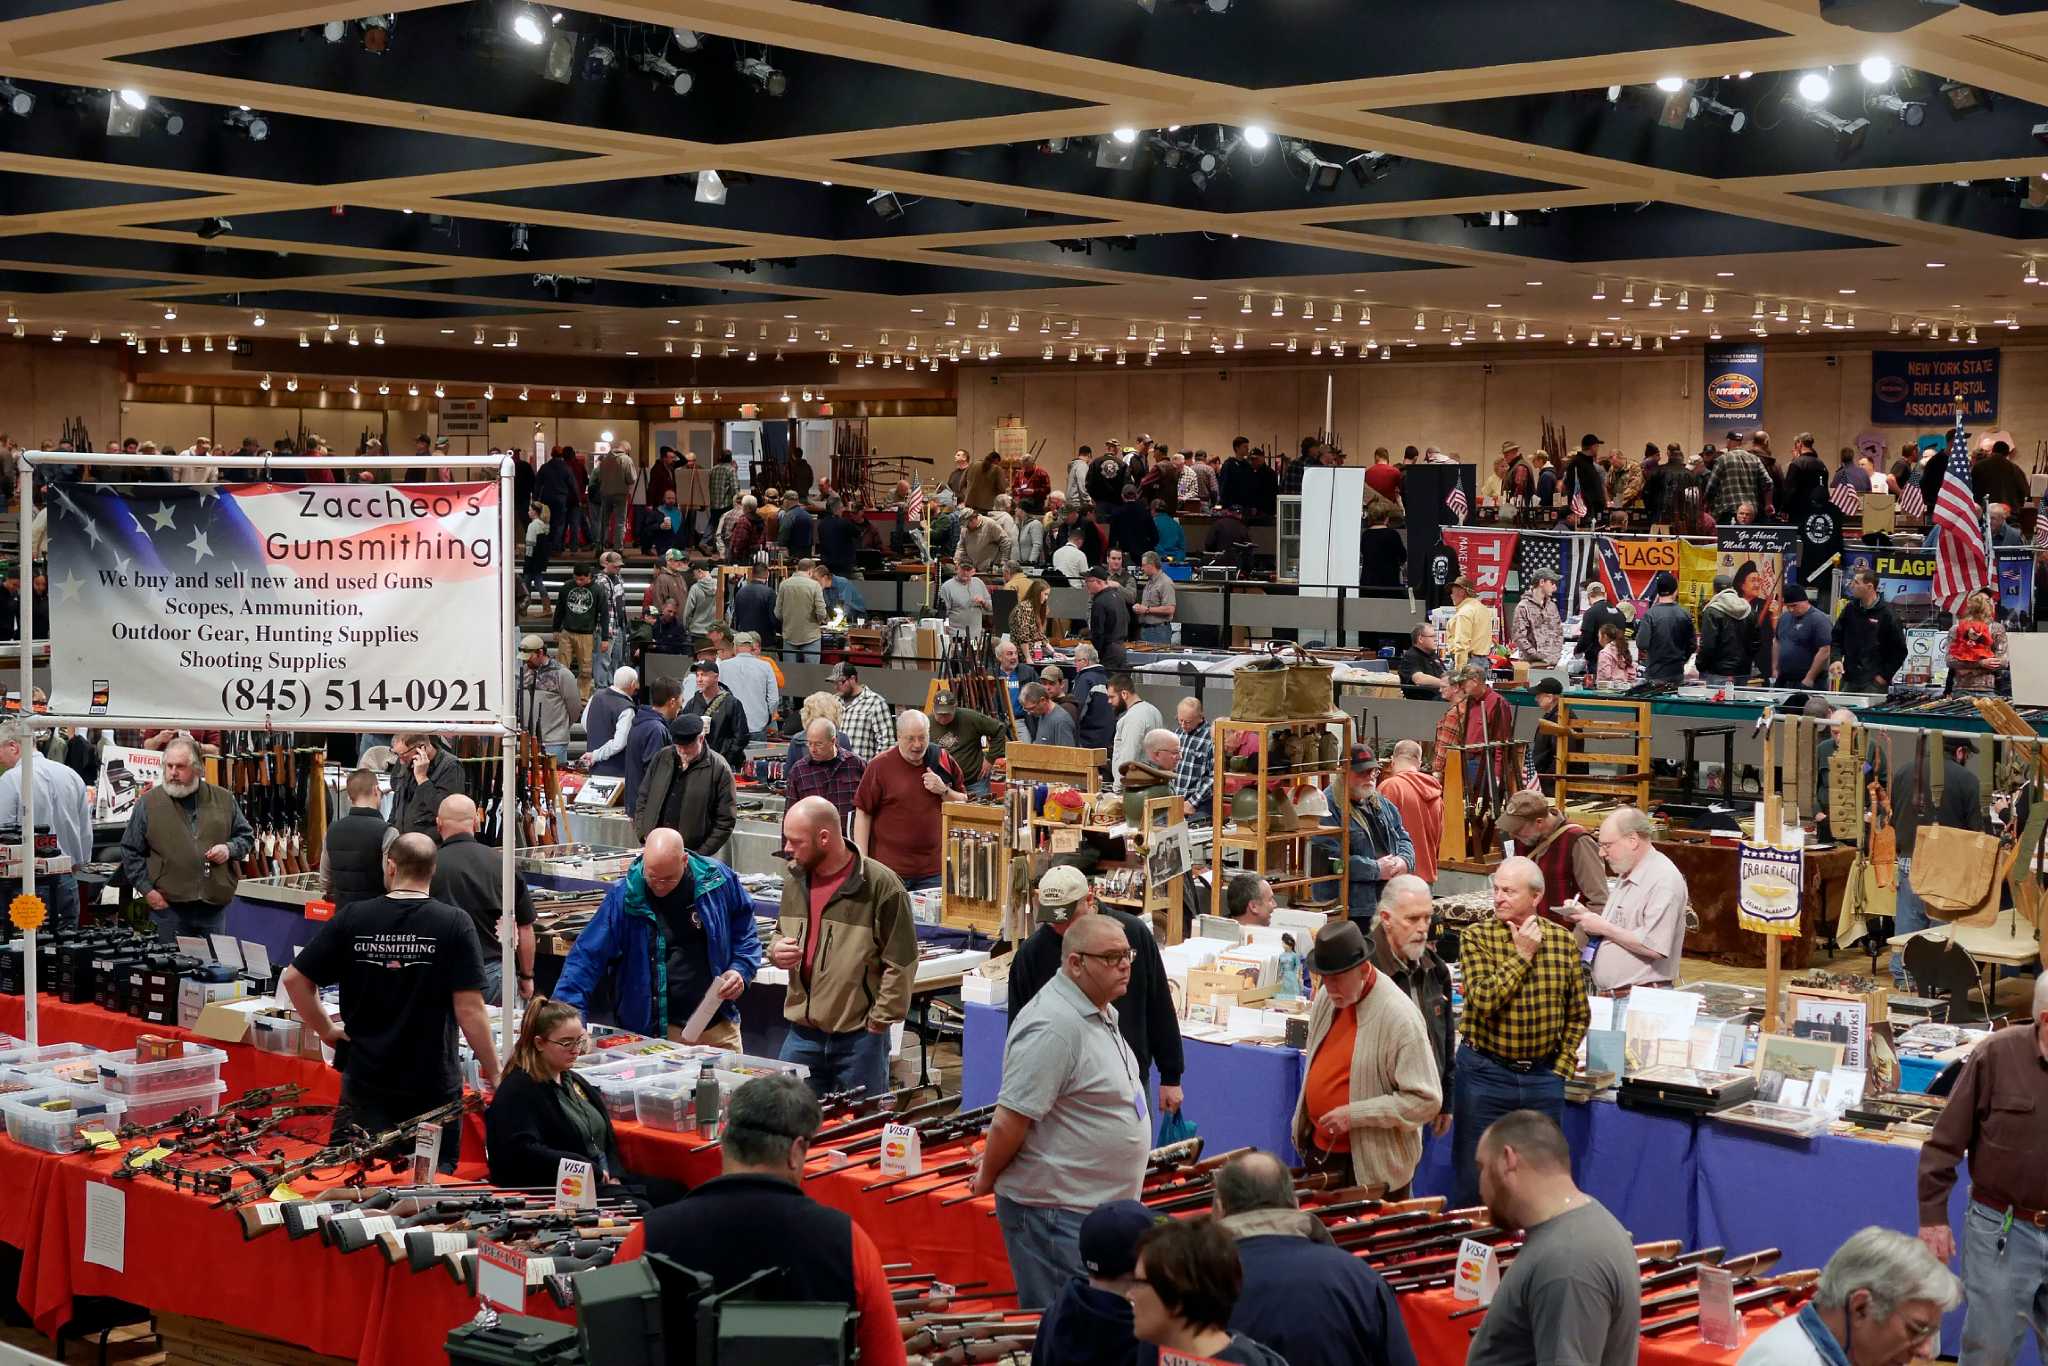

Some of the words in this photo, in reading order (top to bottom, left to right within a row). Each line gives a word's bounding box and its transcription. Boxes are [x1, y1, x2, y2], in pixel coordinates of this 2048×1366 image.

[1908, 361, 1932, 376] NEW
[1933, 361, 1961, 376] YORK
[1962, 360, 1993, 374] STATE
[1913, 382, 1941, 396] RIFLE
[1952, 381, 1986, 395] PISTOL
[299, 490, 481, 518] Zaccheo's
[267, 532, 491, 567] Gunsmithing
[1458, 536, 1468, 561] MAKE
[1617, 545, 1675, 566] FLAGS
[1749, 541, 1764, 552] My
[99, 570, 128, 587] We
[135, 571, 168, 592] buy
[175, 571, 208, 588] and
[215, 571, 244, 588] sell
[251, 577, 288, 589] new
[294, 572, 328, 589] and
[336, 573, 377, 590] used
[384, 573, 432, 590] Guns
[166, 598, 233, 619] Scopes,
[240, 598, 363, 617] Ammunition,
[112, 623, 191, 640] Outdoor
[198, 624, 249, 645] Gear,
[255, 625, 333, 647] Hunting
[338, 626, 418, 647] Supplies
[180, 651, 263, 672] Shooting
[268, 652, 346, 673] Supplies
[222, 678, 311, 718] (845)
[325, 679, 491, 711] 514-0921
[1742, 862, 1770, 880] CRAIG
[375, 933, 417, 942] ZACCHEO'S
[354, 942, 436, 953] GUNSMITHING
[889, 1125, 910, 1136] VISA
[564, 1161, 586, 1174] VISA
[1466, 1242, 1488, 1258] VISA
